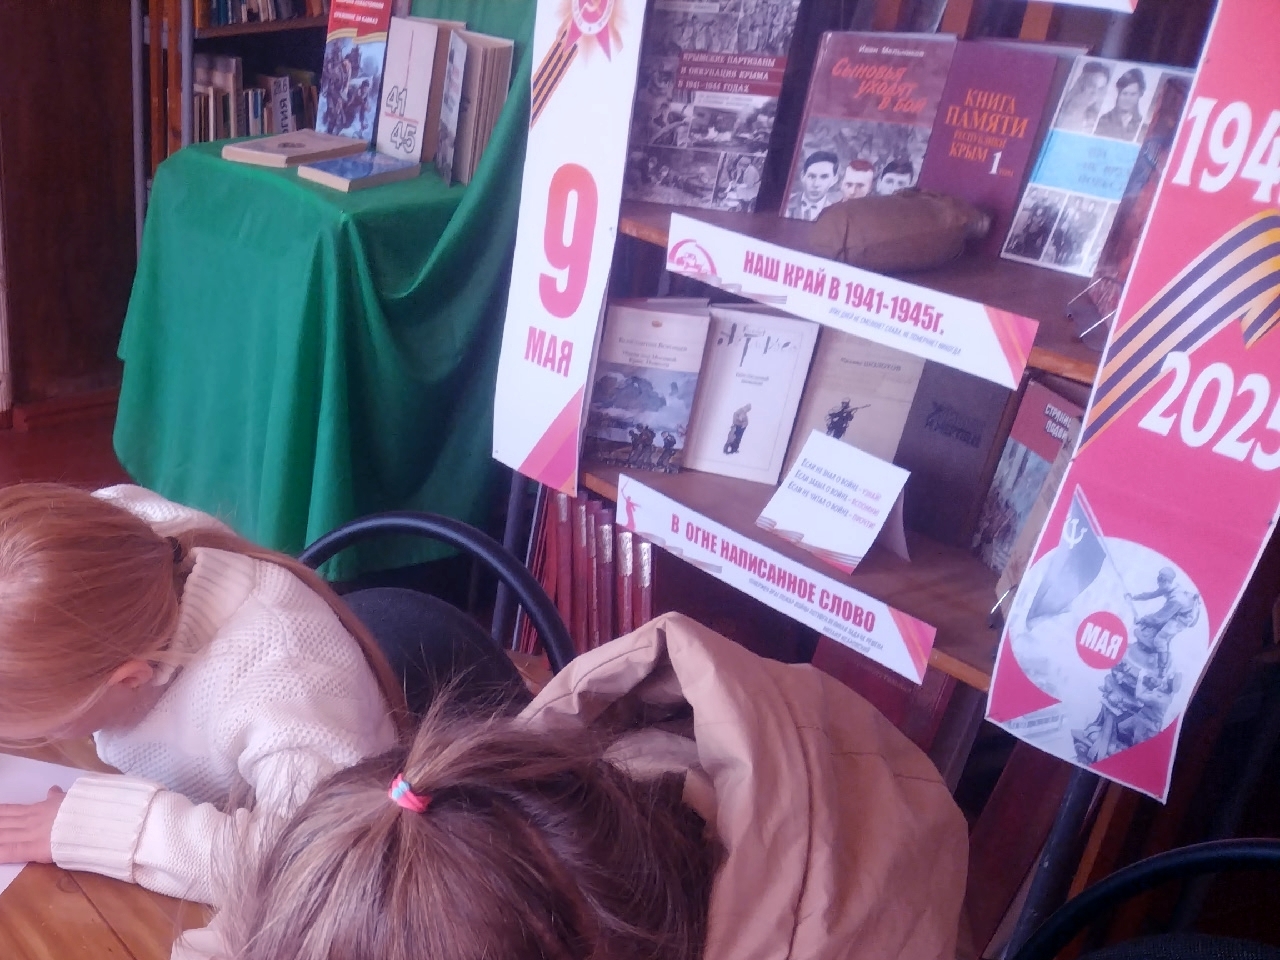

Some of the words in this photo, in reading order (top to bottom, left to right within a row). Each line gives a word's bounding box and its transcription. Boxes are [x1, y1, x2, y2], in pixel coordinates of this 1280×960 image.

[726, 55, 776, 68] ПАРТИЗАНЫ
[738, 71, 769, 81] КРЫМА
[385, 85, 408, 117] 41
[964, 88, 1017, 115] КНИГА
[390, 120, 417, 154] 45
[945, 105, 1029, 138] ПАМЯТИ
[949, 141, 989, 162] КРЫМ
[989, 151, 1002, 175] 1
[1171, 96, 1280, 204] 194
[538, 163, 599, 319] 9
[743, 250, 780, 284] НАШ
[782, 262, 827, 297] КРАЙ
[828, 276, 842, 302] В
[524, 325, 574, 378] МАЯ
[671, 513, 680, 534] В
[685, 521, 718, 555] ОГНЕ
[720, 538, 817, 605] НАПИСАННОЕ
[819, 588, 876, 634] СЛОВО
[1079, 621, 1123, 661] МАЯ
